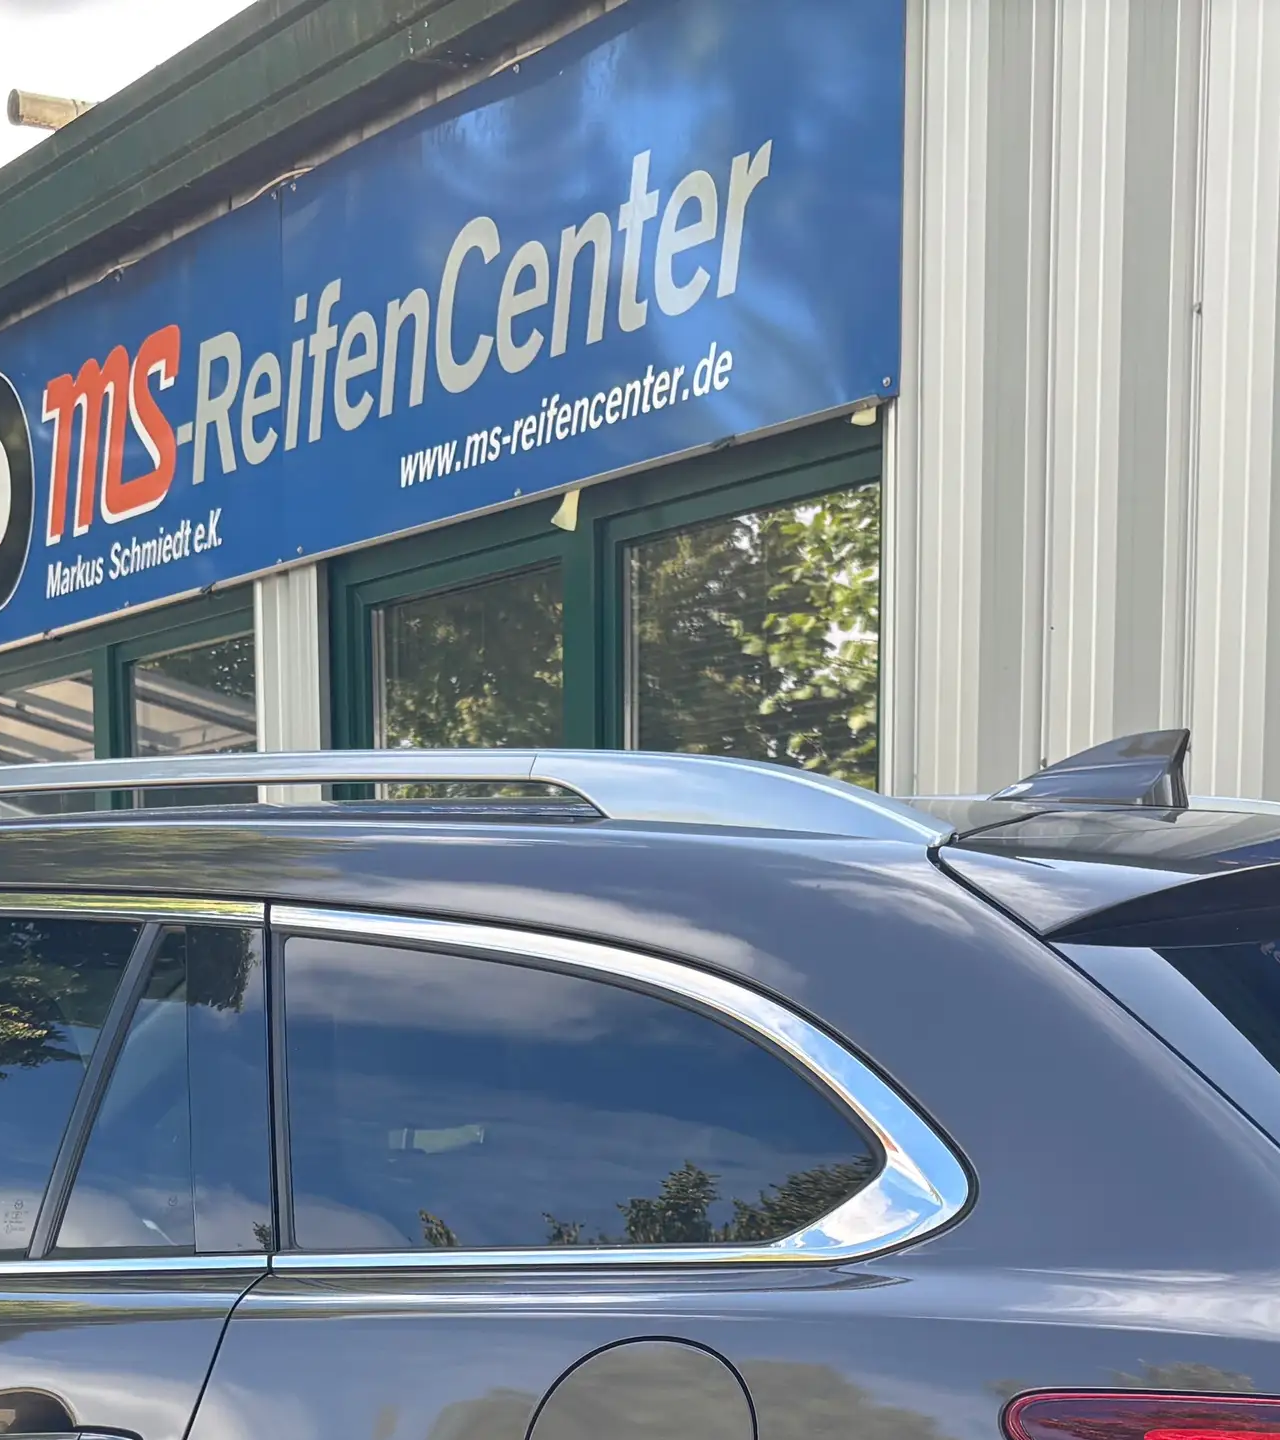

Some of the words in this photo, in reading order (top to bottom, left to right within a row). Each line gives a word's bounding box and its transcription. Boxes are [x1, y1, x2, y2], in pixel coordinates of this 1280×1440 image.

[400, 341, 733, 488] www.ms-reifencenter.de
[46, 555, 104, 599] Markus
[109, 518, 191, 580] Schmiedt
[194, 508, 223, 551] e.K.
